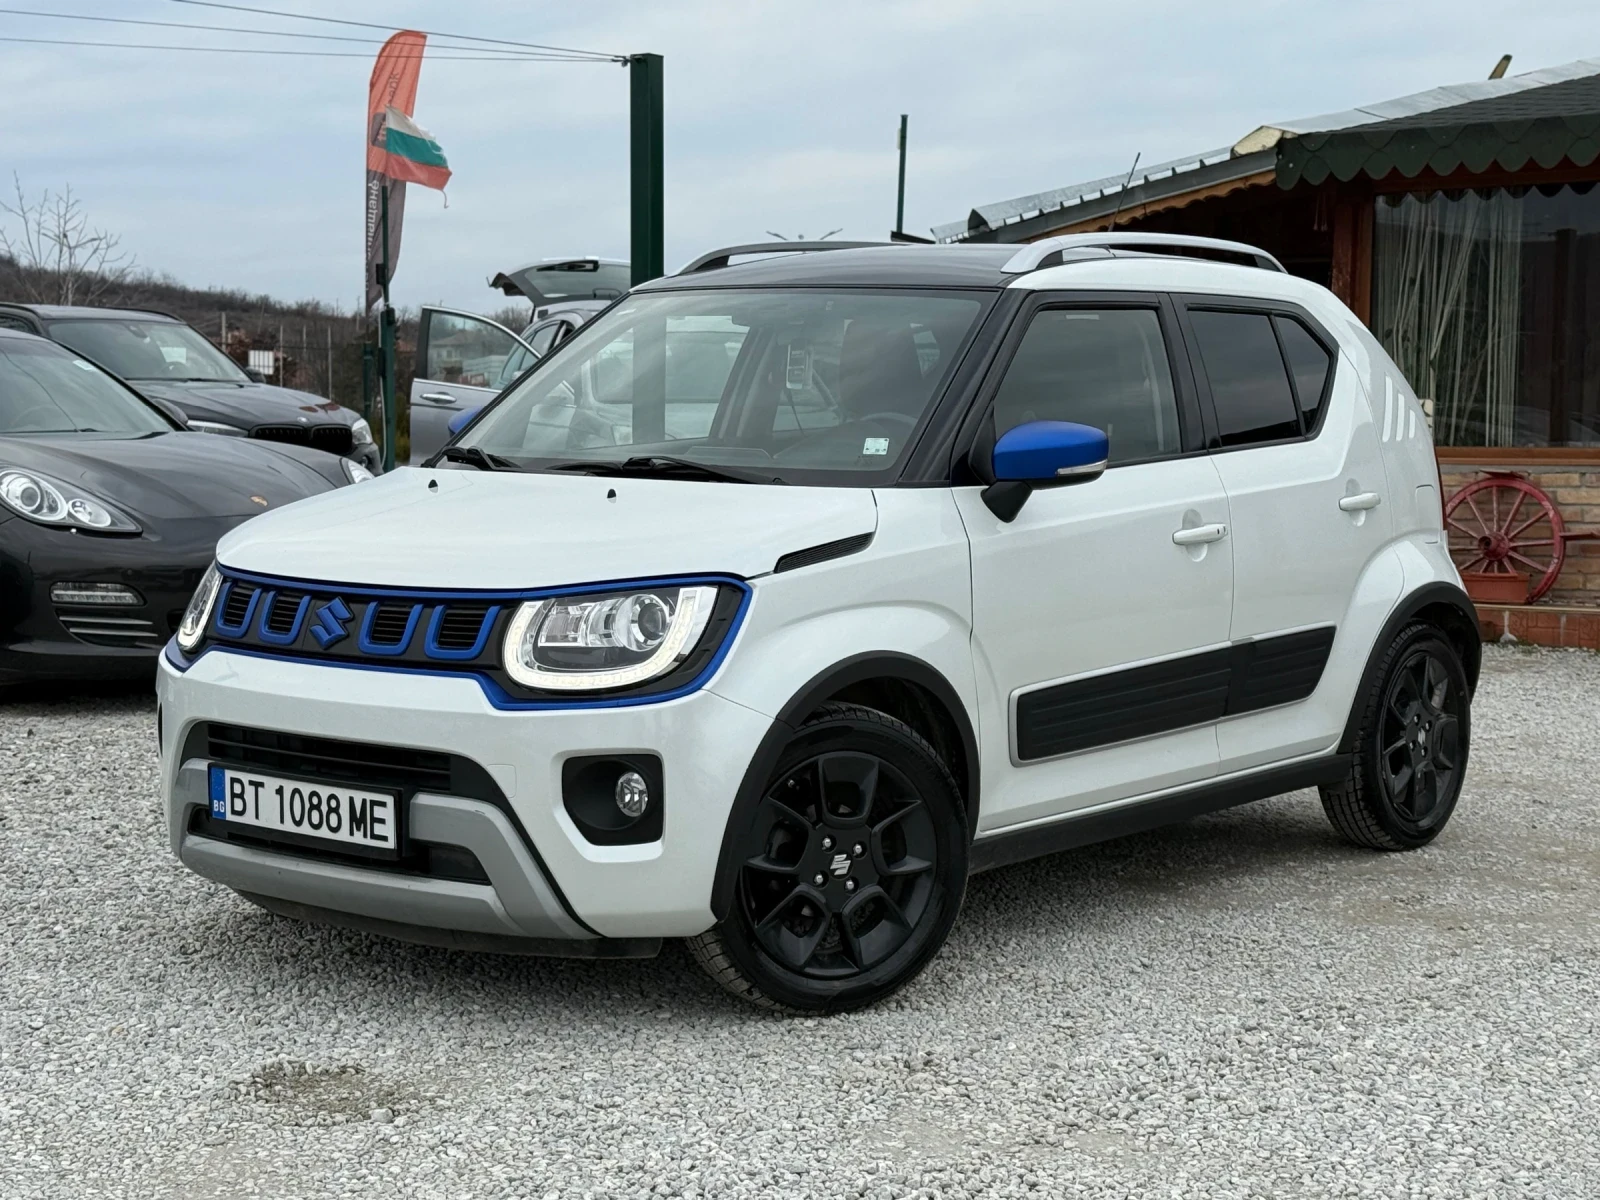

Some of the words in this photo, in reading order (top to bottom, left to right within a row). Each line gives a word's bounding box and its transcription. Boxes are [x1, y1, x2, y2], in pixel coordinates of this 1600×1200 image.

[213, 800, 225, 812] BG
[230, 777, 265, 820] BT
[275, 785, 342, 833] 1088
[349, 796, 388, 842] ME
